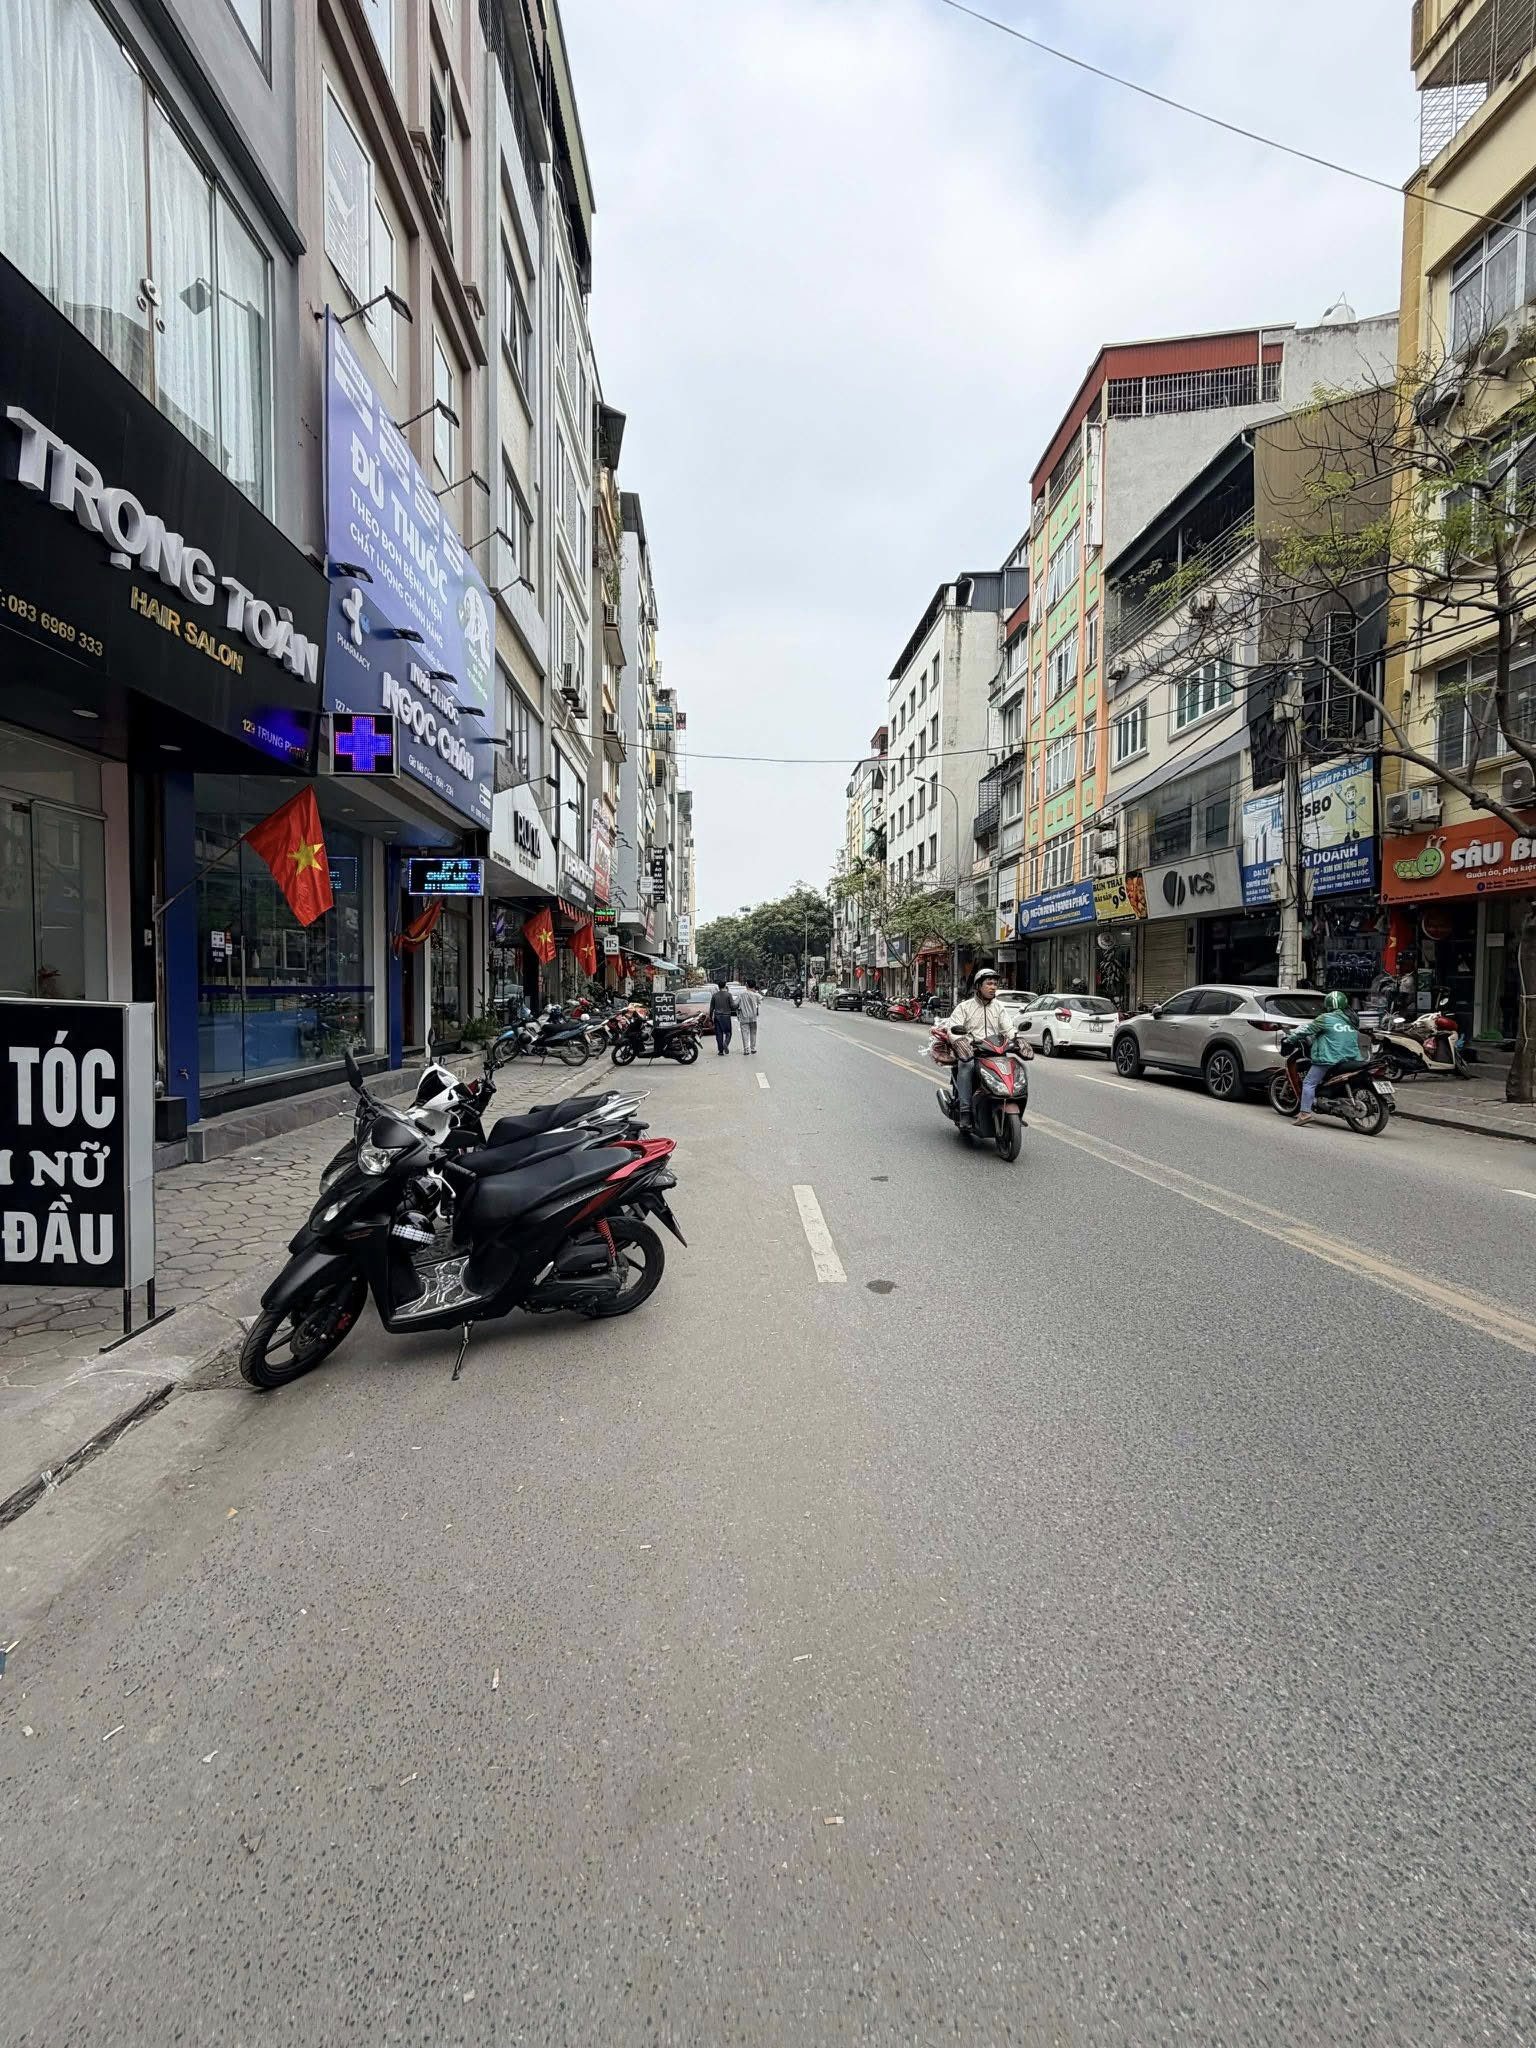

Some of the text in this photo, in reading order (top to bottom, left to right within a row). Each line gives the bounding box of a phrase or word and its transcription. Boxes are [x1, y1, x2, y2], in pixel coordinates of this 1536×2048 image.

[350, 486, 379, 538] THEO
[351, 430, 384, 510] ĐỦ
[391, 489, 447, 606] THUỐC
[7, 405, 215, 606] TRỌNG
[221, 576, 319, 684] TOÀN
[350, 522, 375, 563] CHẤT
[376, 552, 404, 599] LƯỢNG
[8, 595, 103, 656] 083 6969 333
[130, 585, 243, 675] HAIR SALON
[336, 631, 370, 671] PHARMACY
[411, 662, 432, 699] NHÀ
[431, 684, 459, 726] THUỐC
[257, 725, 284, 749] TRUNG
[382, 671, 437, 747] NGỌC
[437, 727, 474, 782] CHÂU
[1299, 795, 1332, 820] ESBO
[1313, 844, 1359, 866] DOANH
[1451, 839, 1504, 871] SÂU
[1188, 871, 1215, 896] ICS
[655, 994, 673, 1003] CẮT
[655, 1004, 674, 1012] TÓC
[1333, 1023, 1355, 1032] Gr
[9, 1030, 116, 1128] TÓC
[29, 1141, 110, 1188] NỮ
[1, 1194, 114, 1265] ĐẦU
